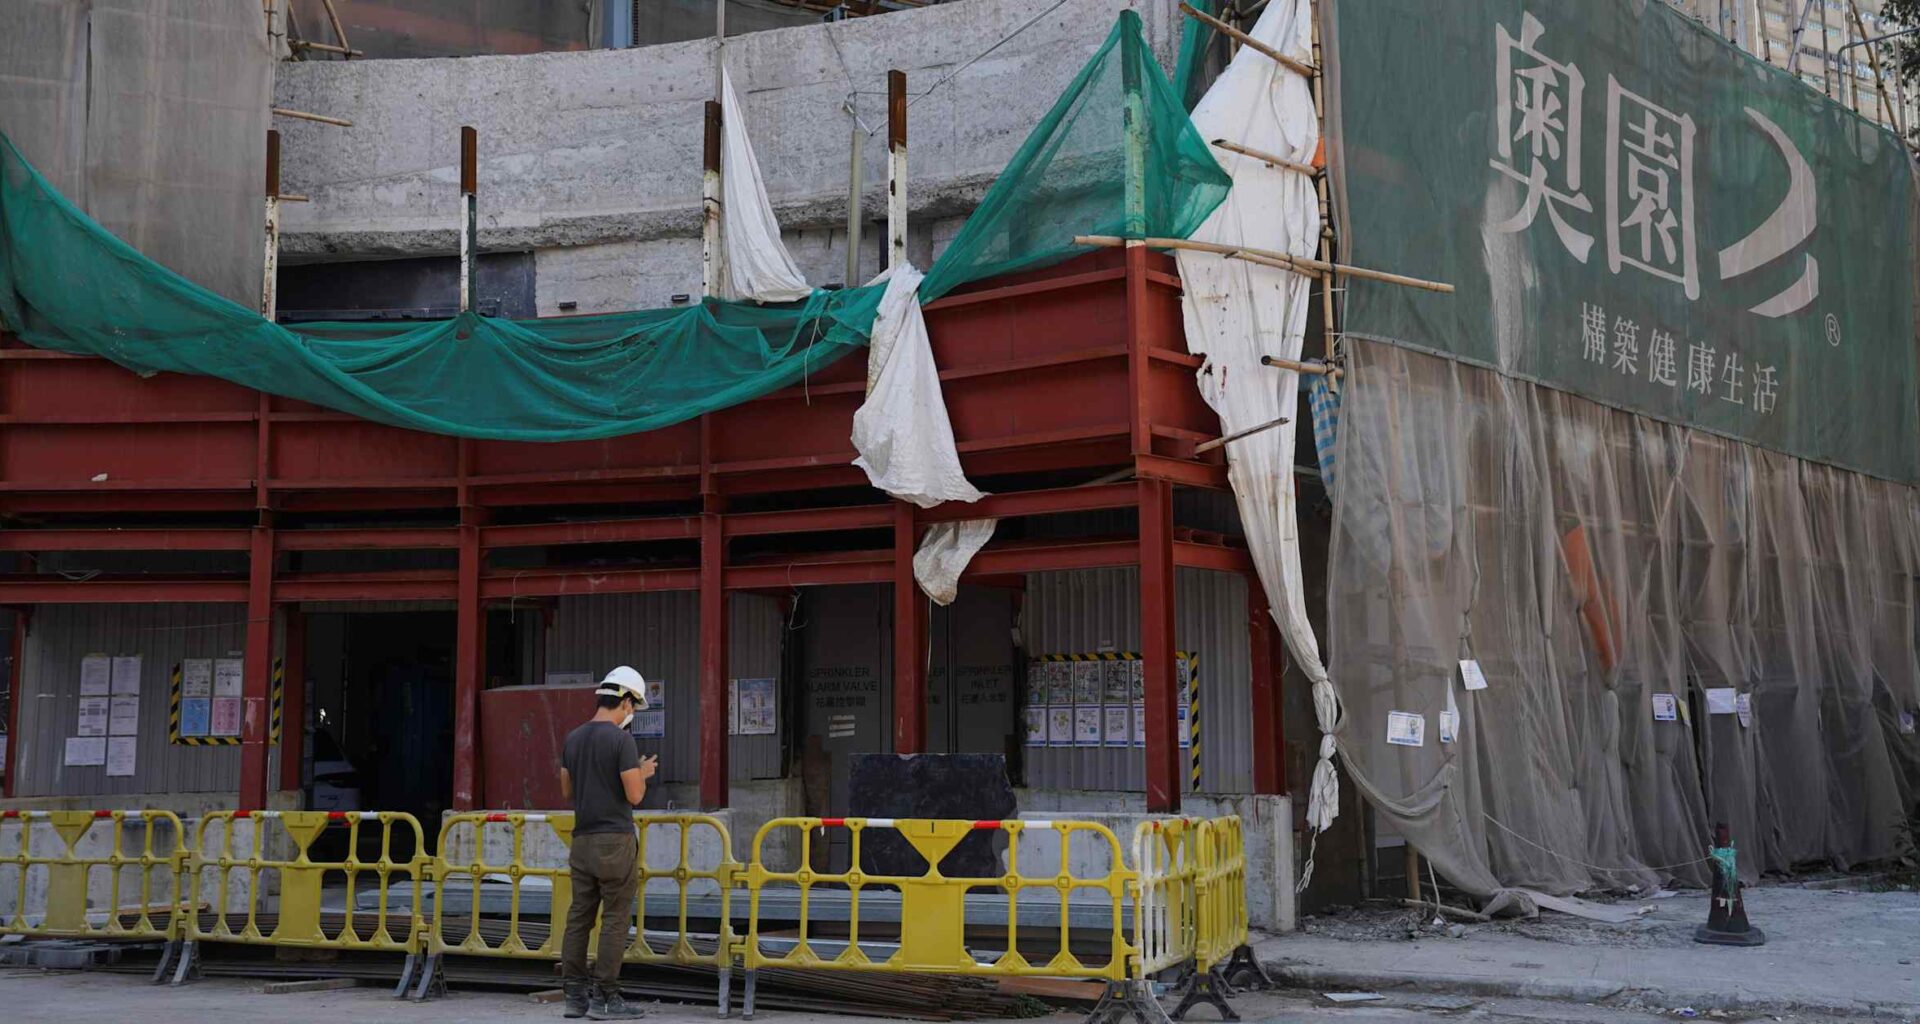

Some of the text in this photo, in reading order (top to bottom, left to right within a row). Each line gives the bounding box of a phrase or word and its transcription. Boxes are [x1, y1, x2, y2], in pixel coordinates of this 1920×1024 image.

[1489, 10, 1700, 300] 奧園
[1580, 302, 1779, 415] 構築健康生活
[809, 666, 870, 678] SPRINKLER
[804, 680, 877, 692] ALARM VALVE
[971, 678, 999, 689] INLET
